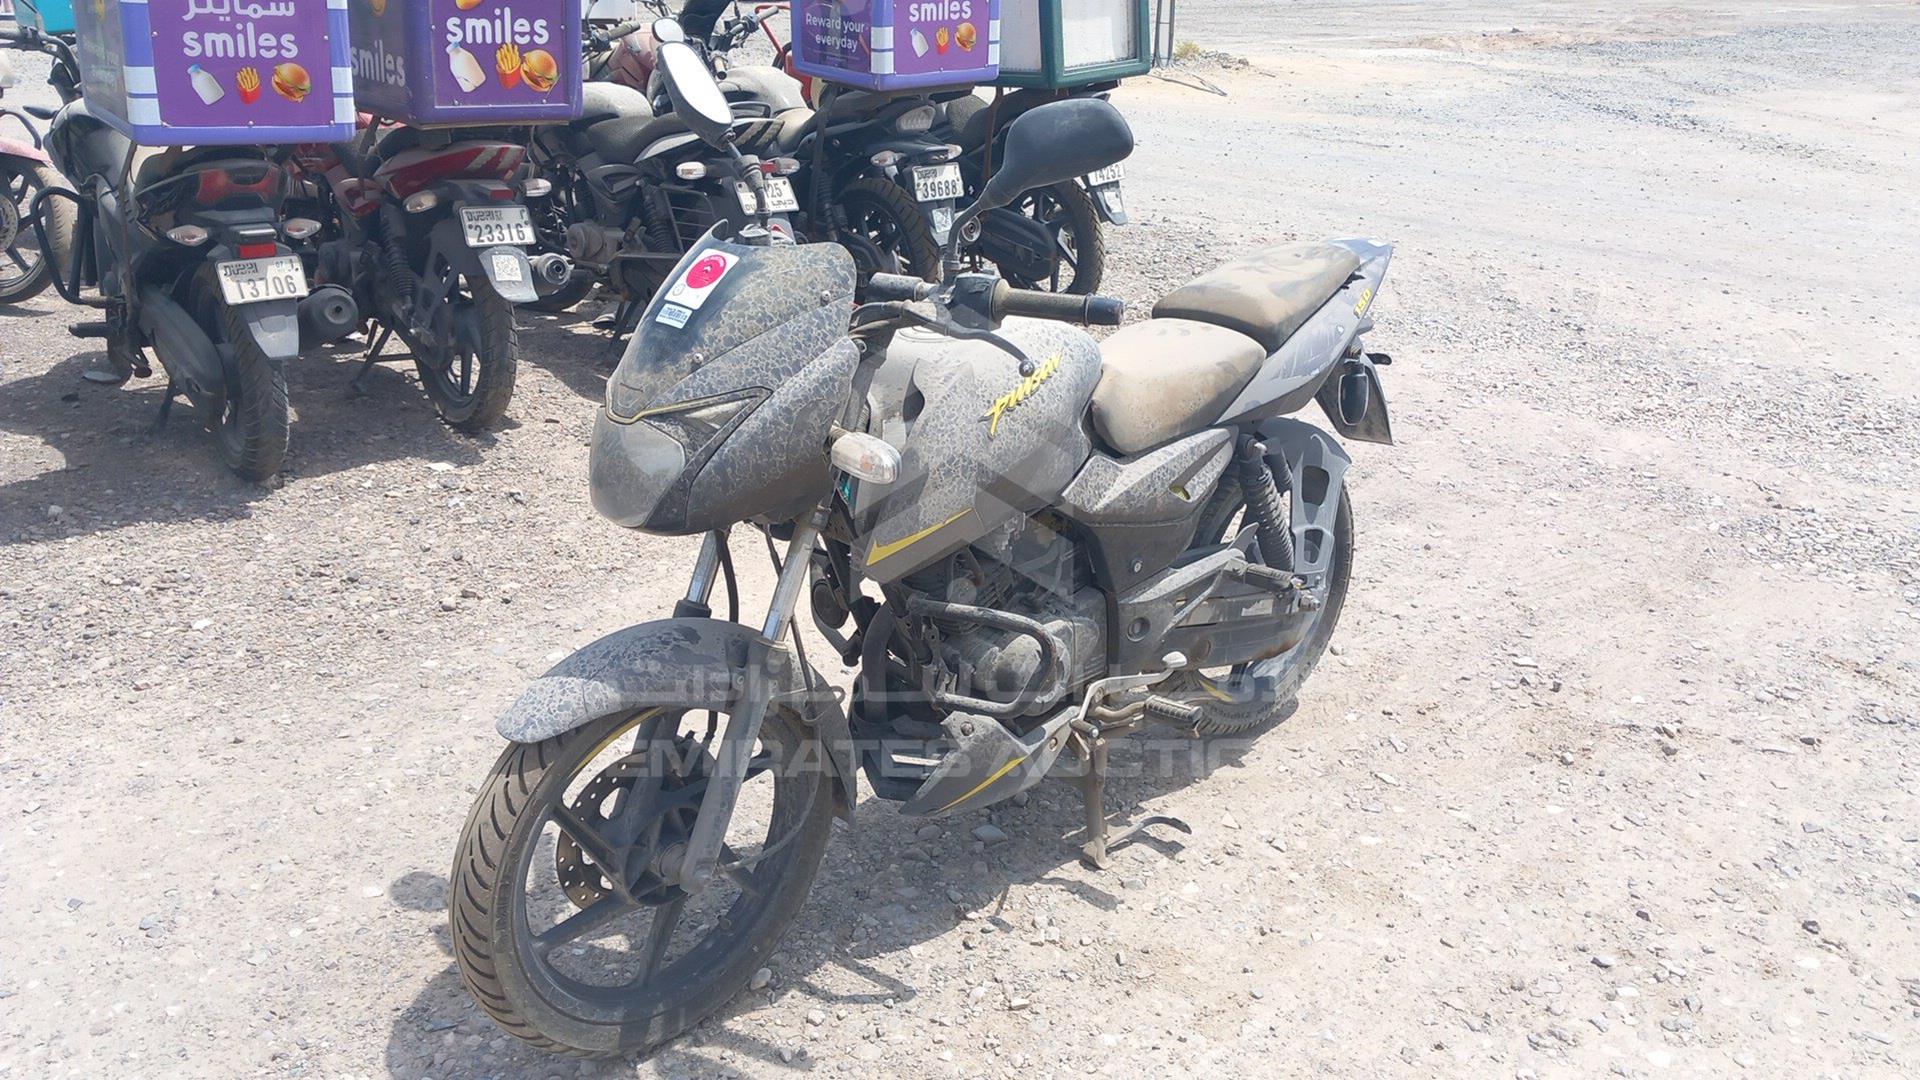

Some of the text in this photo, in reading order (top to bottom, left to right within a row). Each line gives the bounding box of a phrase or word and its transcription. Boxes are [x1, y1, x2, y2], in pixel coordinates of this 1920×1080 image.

[446, 7, 549, 44] smiles
[805, 13, 865, 33] Reward your
[182, 21, 298, 58] smiles
[815, 34, 858, 53] everyday
[351, 40, 405, 87] smiles
[922, 179, 957, 198] 39688
[474, 223, 526, 243] 23316
[237, 275, 297, 300] 13706
